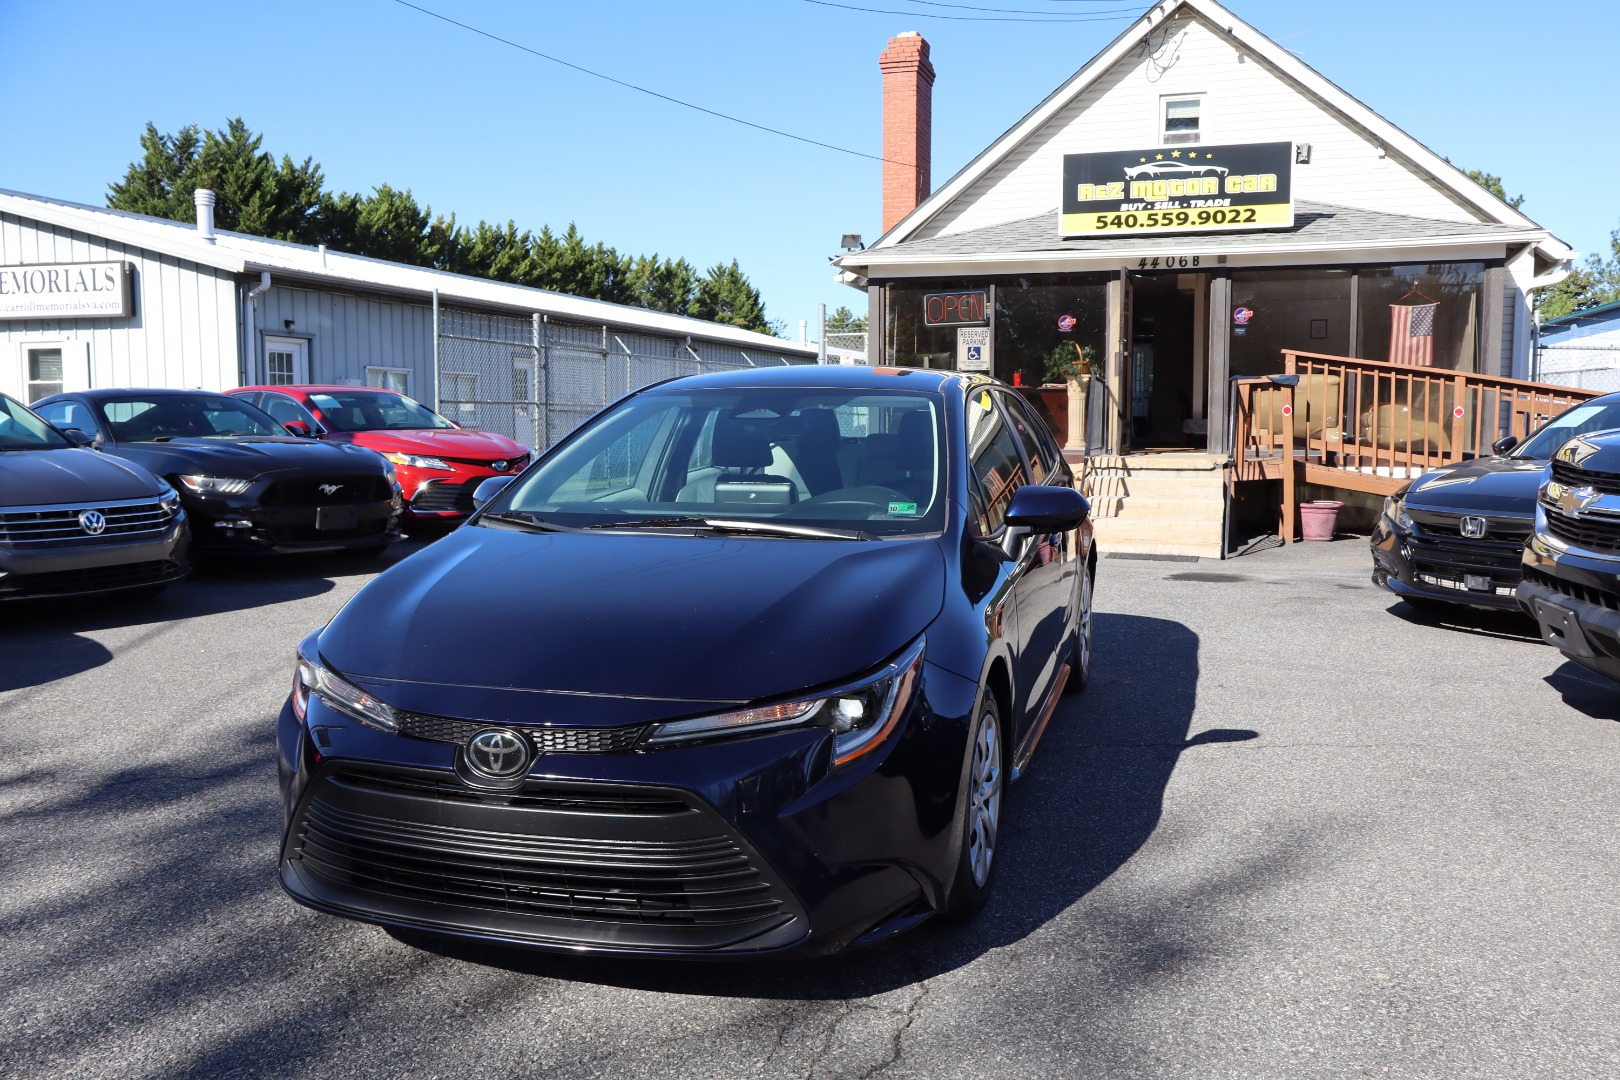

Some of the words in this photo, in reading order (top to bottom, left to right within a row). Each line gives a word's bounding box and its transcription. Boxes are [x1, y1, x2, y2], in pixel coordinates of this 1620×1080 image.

[1120, 202, 1147, 212] BUY
[1153, 200, 1181, 210] SELL
[1190, 198, 1231, 208] TRADE
[1095, 208, 1257, 230] 540.559.9022
[1138, 255, 1200, 269] 4406B
[927, 294, 984, 323] OPEN
[960, 330, 989, 338] RESERVED
[962, 338, 987, 346] PARKING
